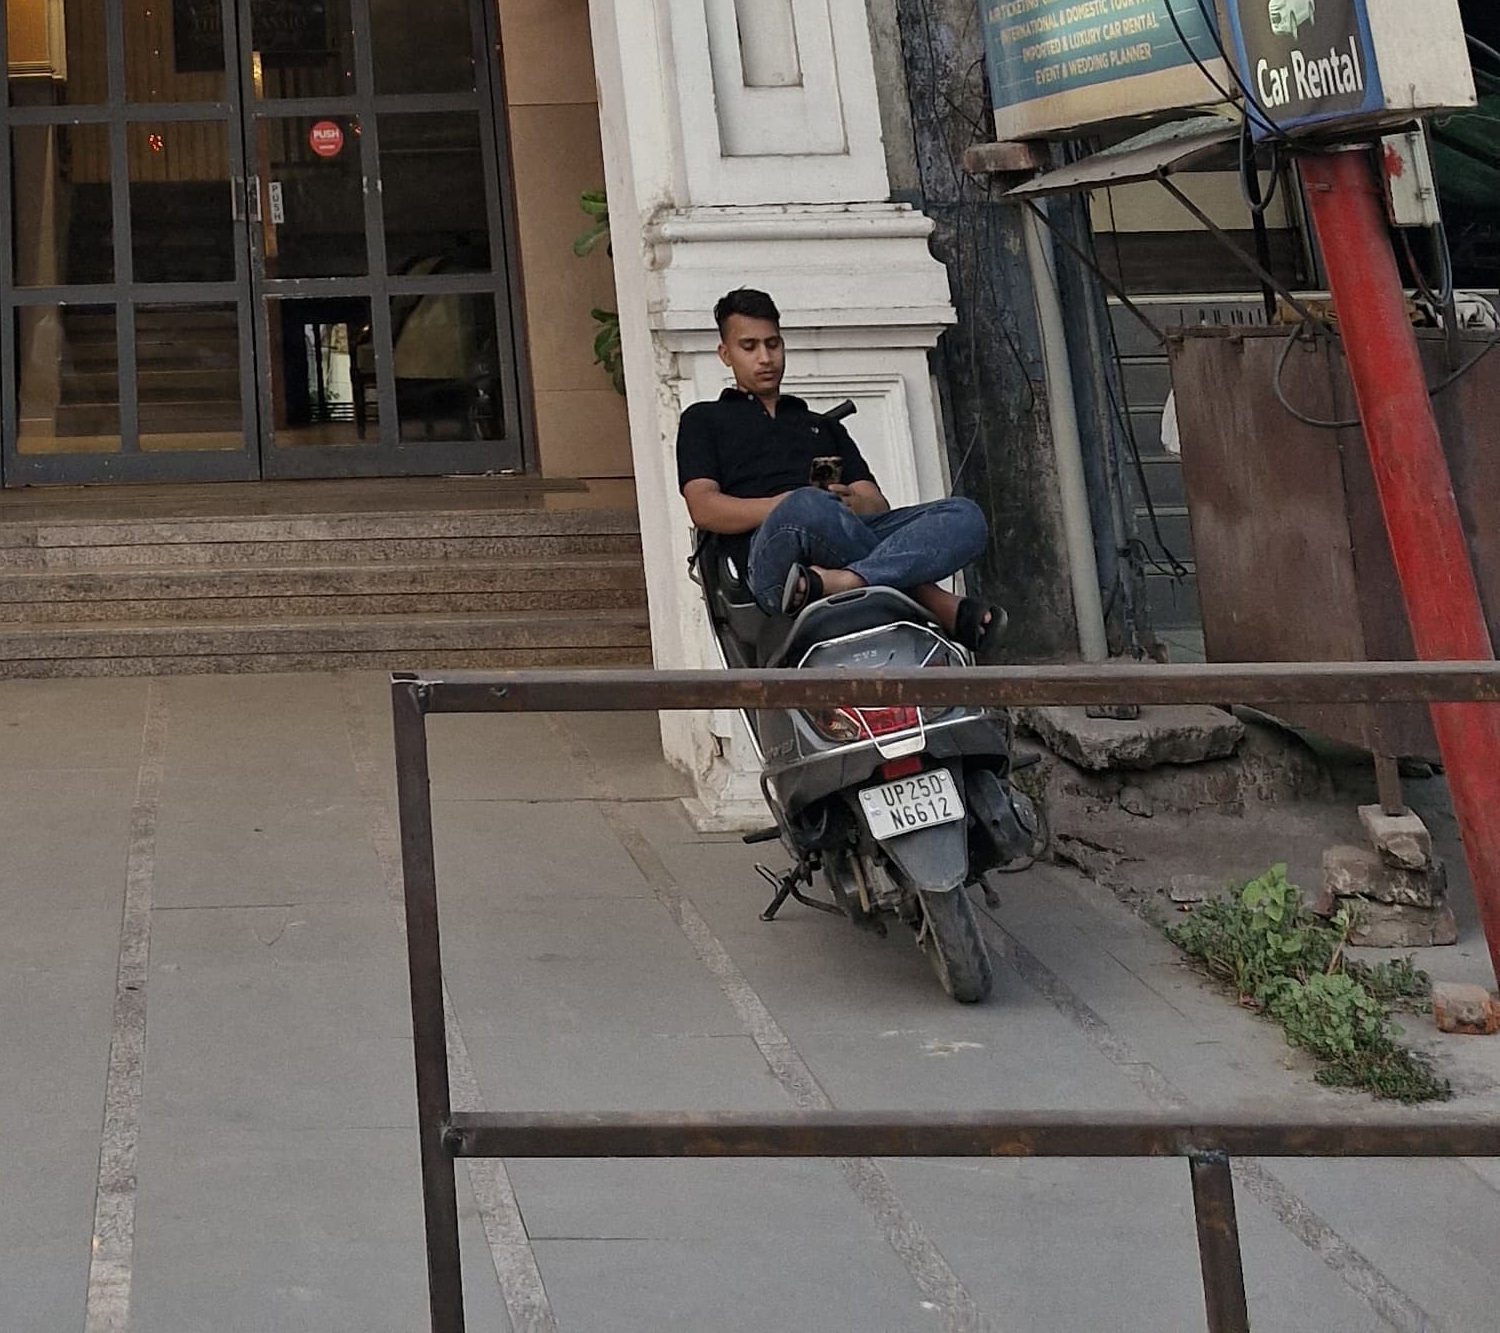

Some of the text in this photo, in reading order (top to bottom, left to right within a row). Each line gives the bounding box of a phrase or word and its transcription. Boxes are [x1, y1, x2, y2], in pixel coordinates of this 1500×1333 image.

[1022, 38, 1062, 64] IMPORTED
[1069, 26, 1101, 50] LUXURY
[1102, 21, 1122, 42] CAR
[1122, 11, 1160, 37] RENTAL
[1035, 65, 1062, 86] EVENT
[1068, 52, 1109, 77] WEDDING
[1110, 41, 1153, 68] PLANNER
[1256, 35, 1364, 110] Car Rental
[313, 129, 340, 139] PUSH
[271, 184, 281, 221] PUSH
[880, 773, 943, 809] UP25D
[890, 796, 953, 832] N6612
